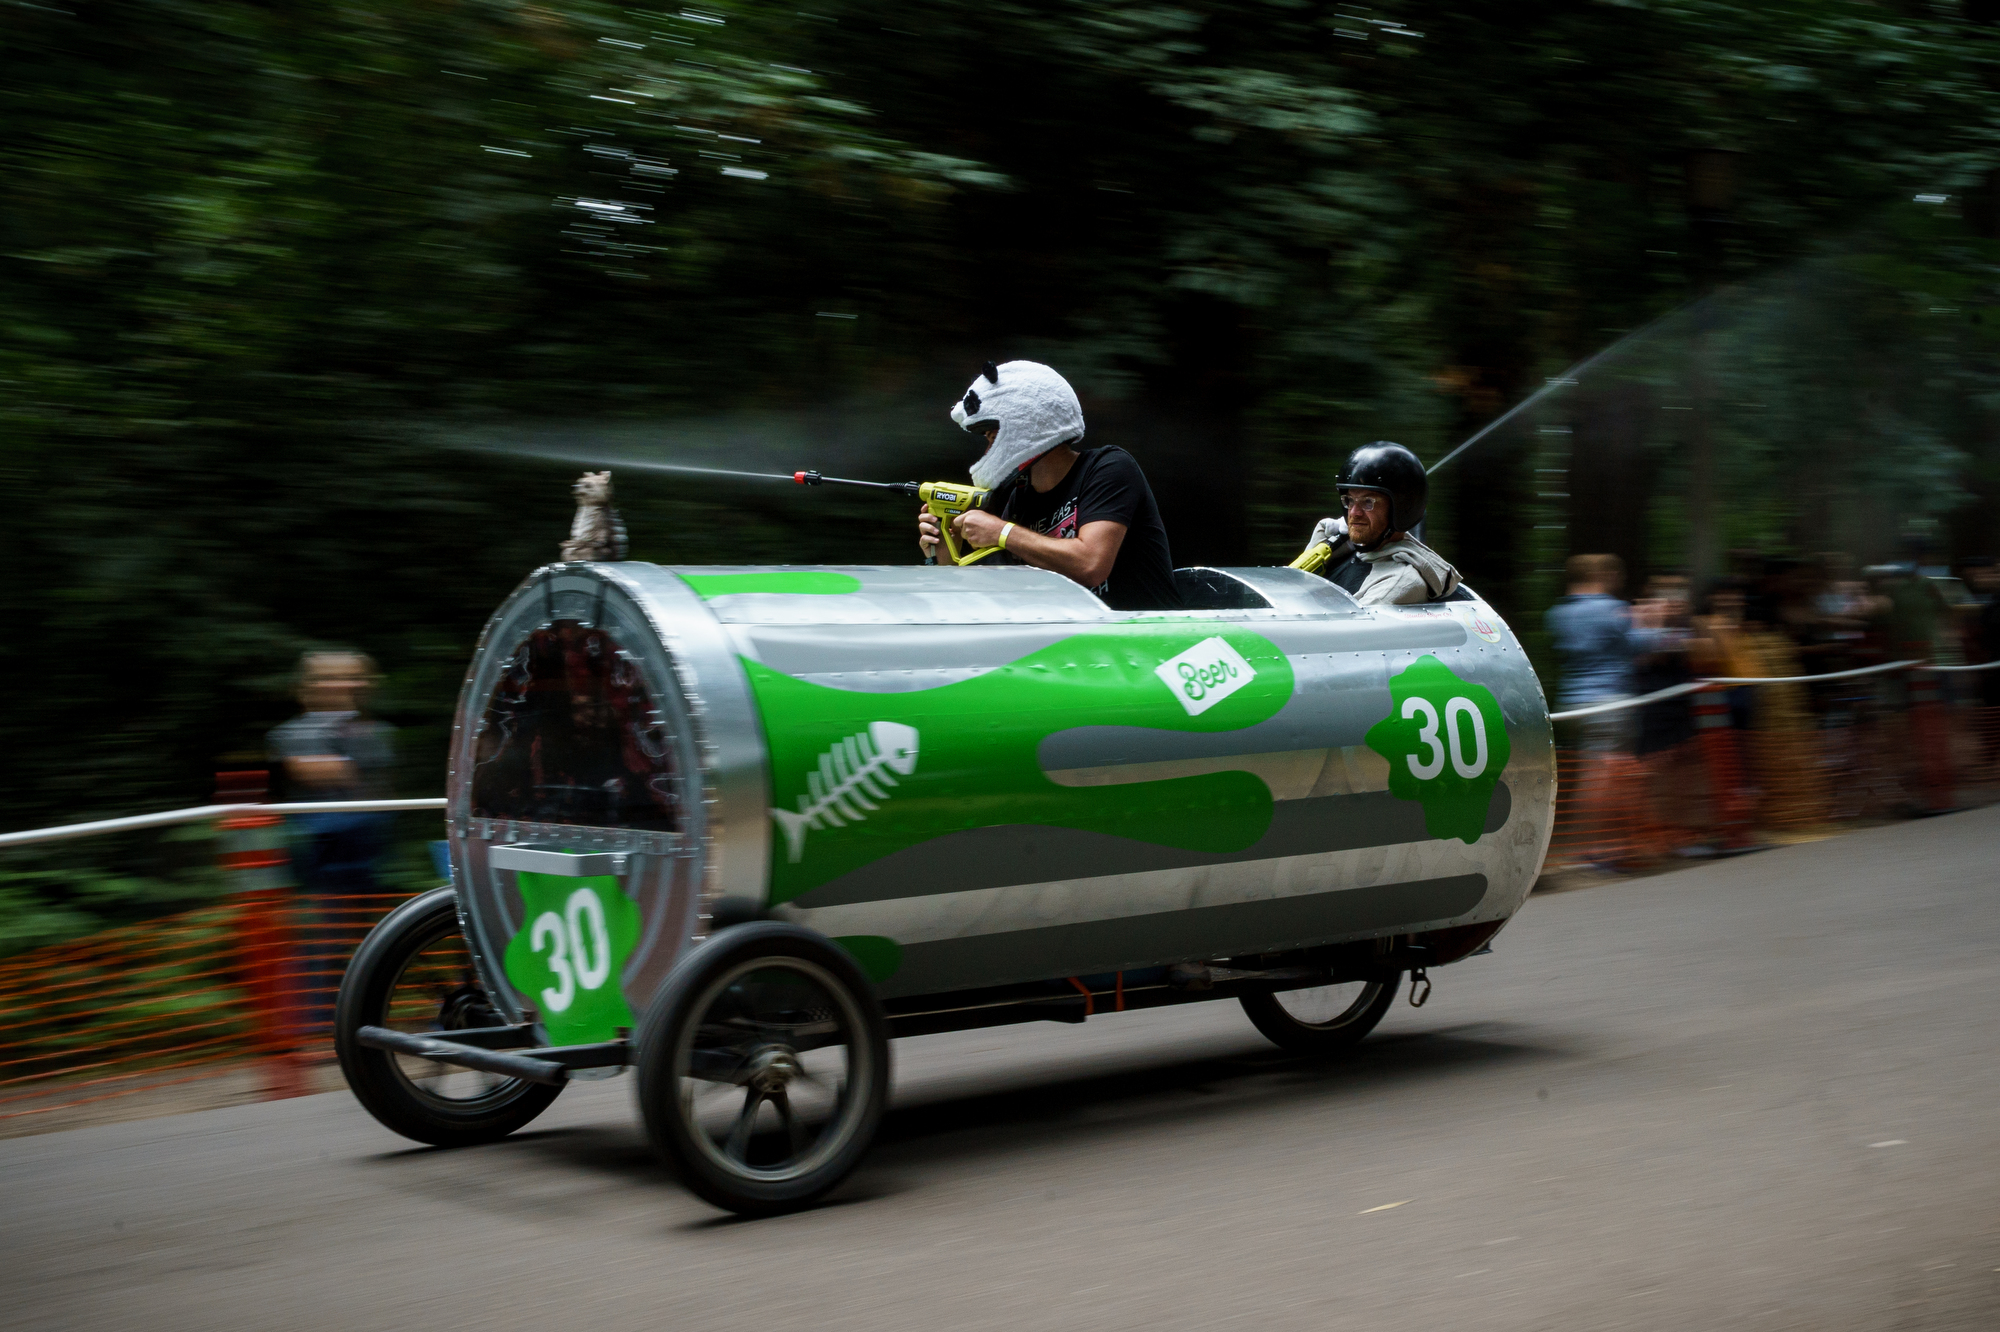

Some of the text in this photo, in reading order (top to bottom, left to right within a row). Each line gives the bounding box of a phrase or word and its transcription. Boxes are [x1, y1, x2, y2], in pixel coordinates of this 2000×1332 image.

[936, 491, 957, 502] RYOBI
[1177, 657, 1239, 701] Beer
[1401, 696, 1488, 780] 30
[530, 888, 611, 1012] 30
